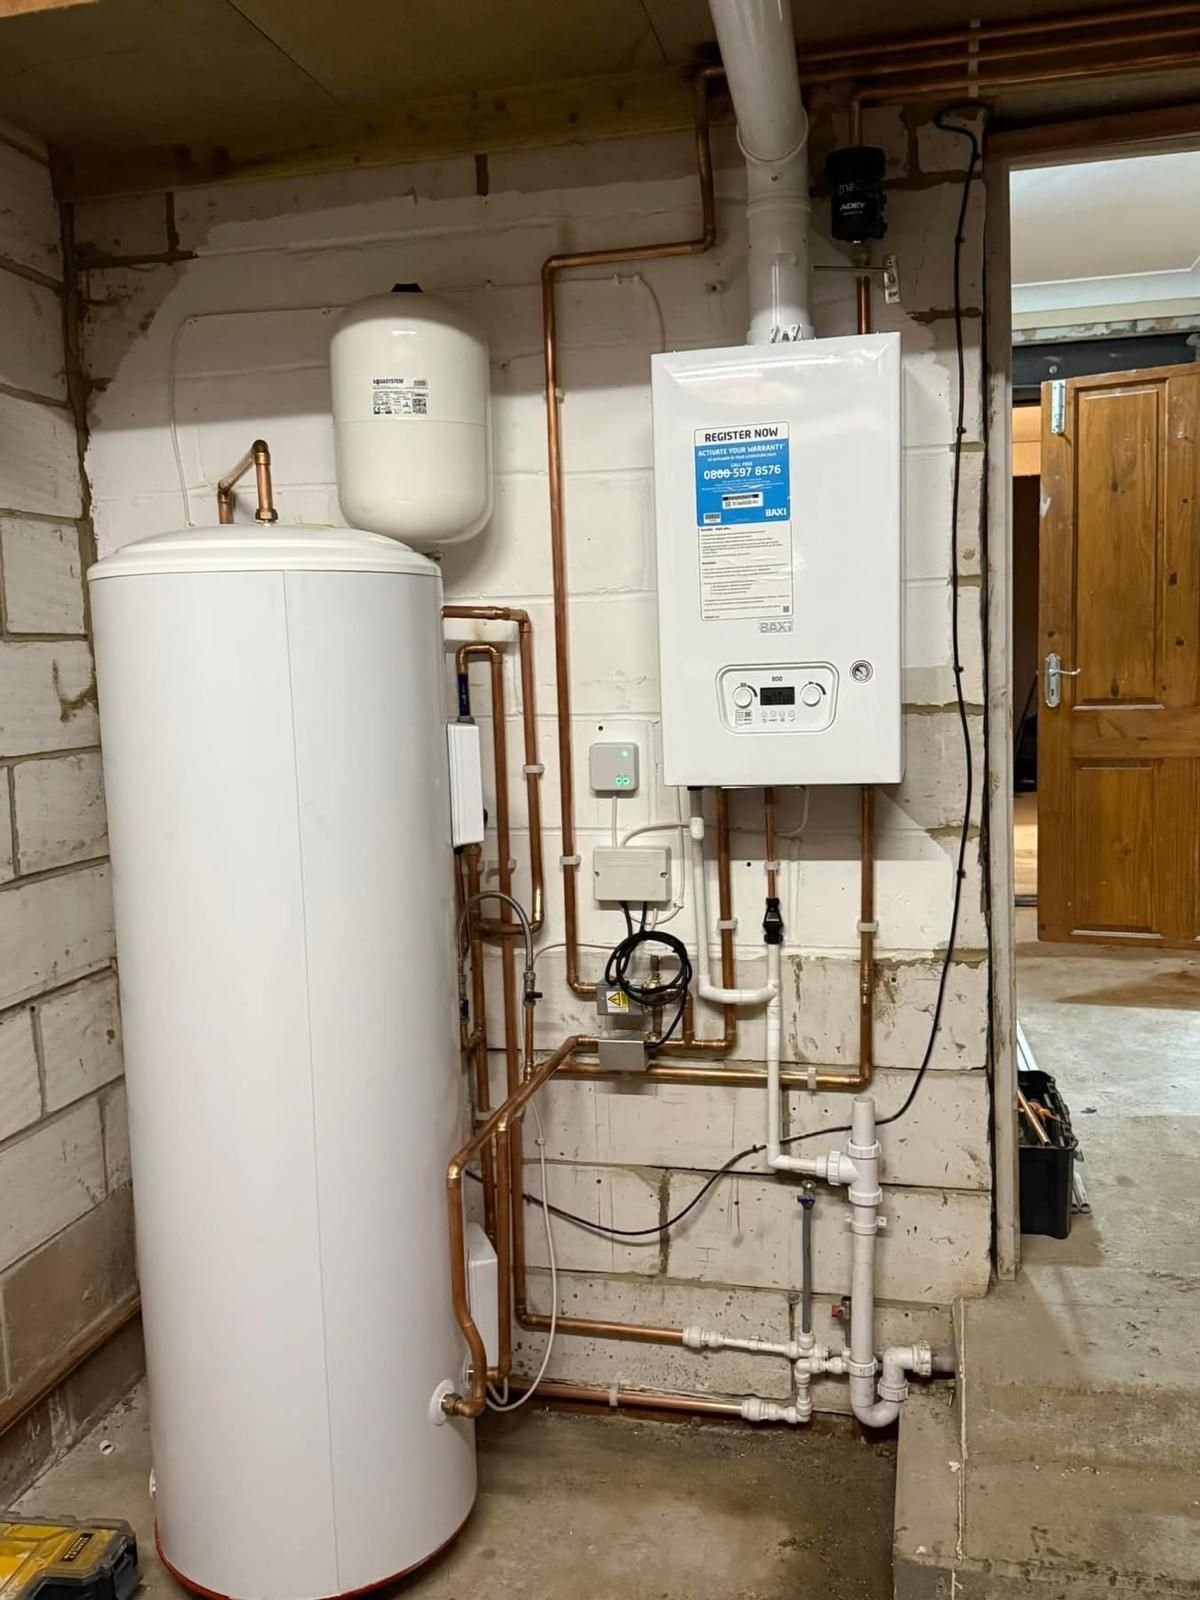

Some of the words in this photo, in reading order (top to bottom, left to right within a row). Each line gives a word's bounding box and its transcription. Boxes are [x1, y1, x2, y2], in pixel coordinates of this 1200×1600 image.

[705, 430, 751, 442] REGISTER
[754, 427, 778, 438] NOW
[698, 447, 727, 457] ACTIVATE
[729, 446, 746, 454] YOUR
[747, 443, 783, 453] WARRANTY
[704, 469, 730, 480] 0800
[733, 467, 752, 478] 597
[755, 464, 781, 476] 8576
[766, 508, 786, 517] BAXI
